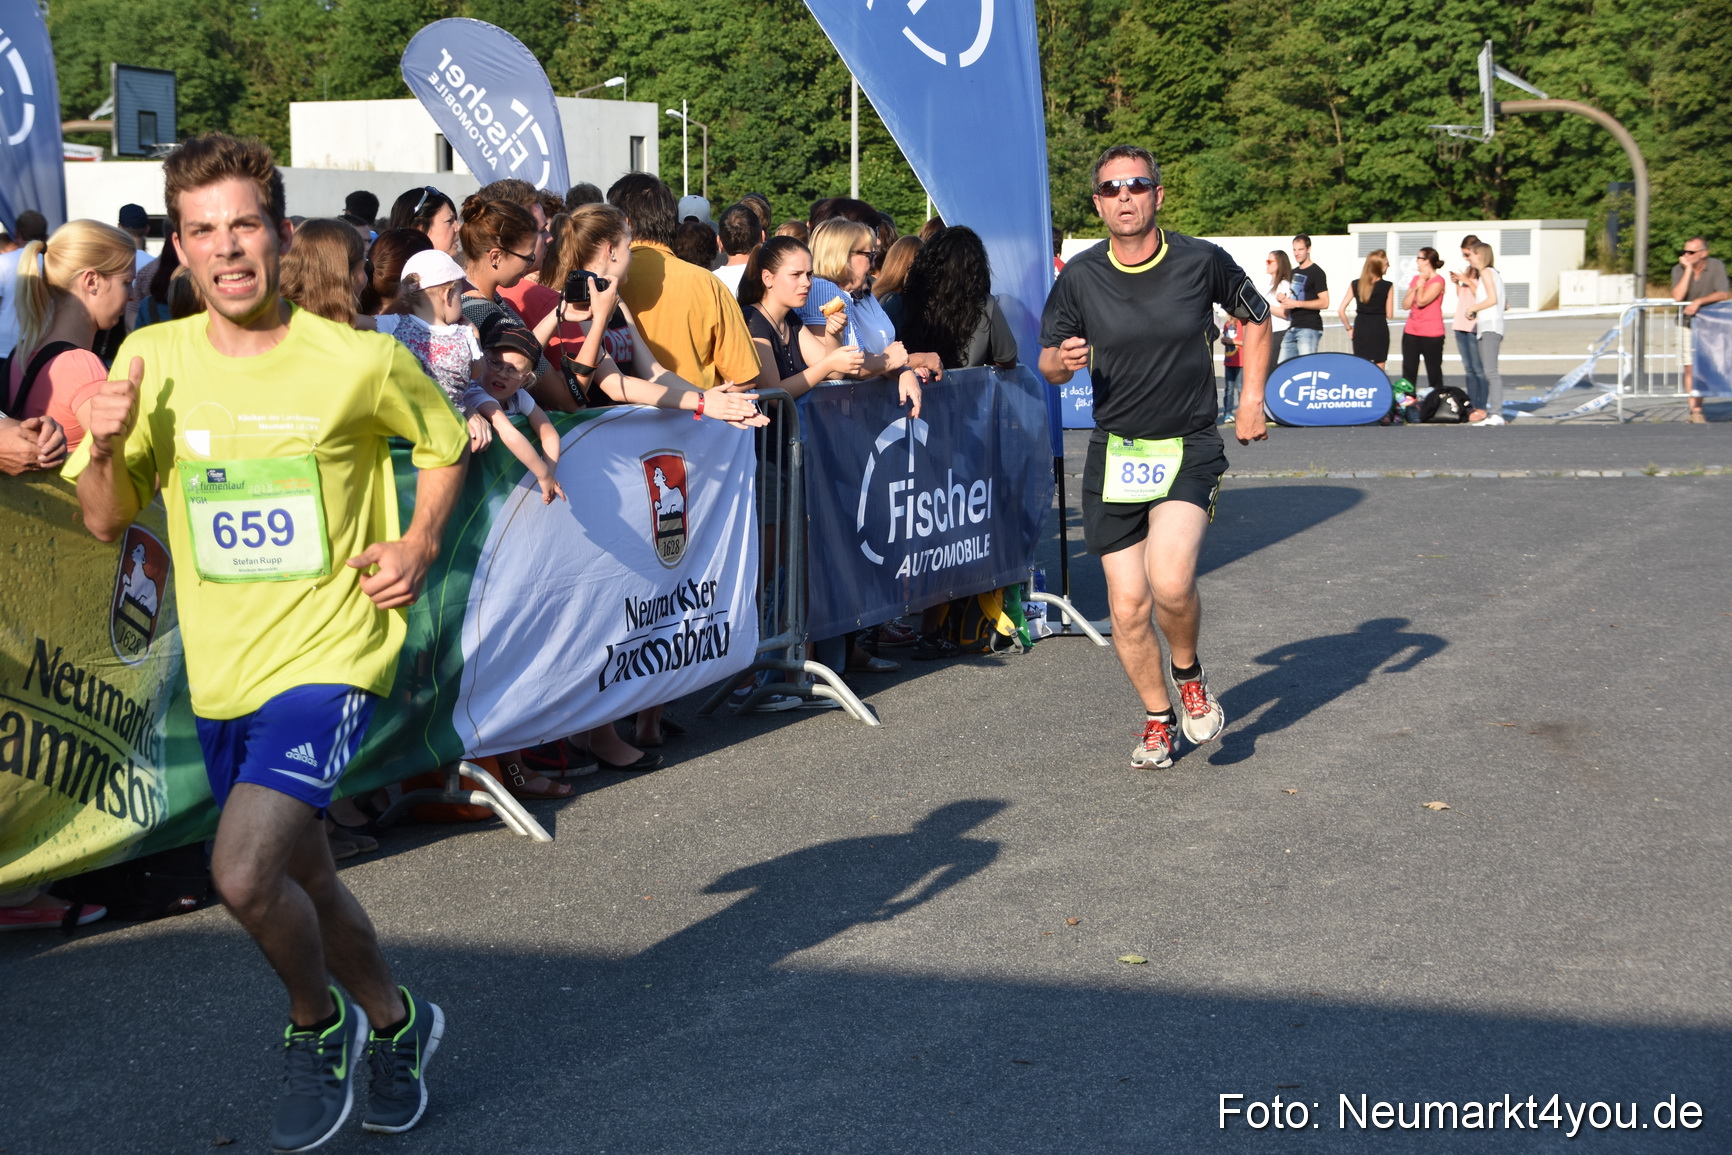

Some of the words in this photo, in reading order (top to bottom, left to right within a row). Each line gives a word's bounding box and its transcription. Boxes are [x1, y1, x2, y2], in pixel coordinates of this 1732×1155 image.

[603, 328, 632, 361] OBE
[568, 378, 583, 400] SONY
[1298, 384, 1378, 401] Fischer
[1306, 401, 1373, 410] AUTOMOBILE
[1121, 462, 1166, 484] 836
[200, 480, 246, 491] firmenlauf
[212, 508, 295, 549] 659
[663, 539, 680, 557] 1628
[895, 532, 991, 579] AUTOMOBILE
[233, 557, 259, 566] Stefan
[260, 556, 283, 566] Rupp
[118, 627, 142, 655] 1628
[285, 751, 318, 767] adidas
